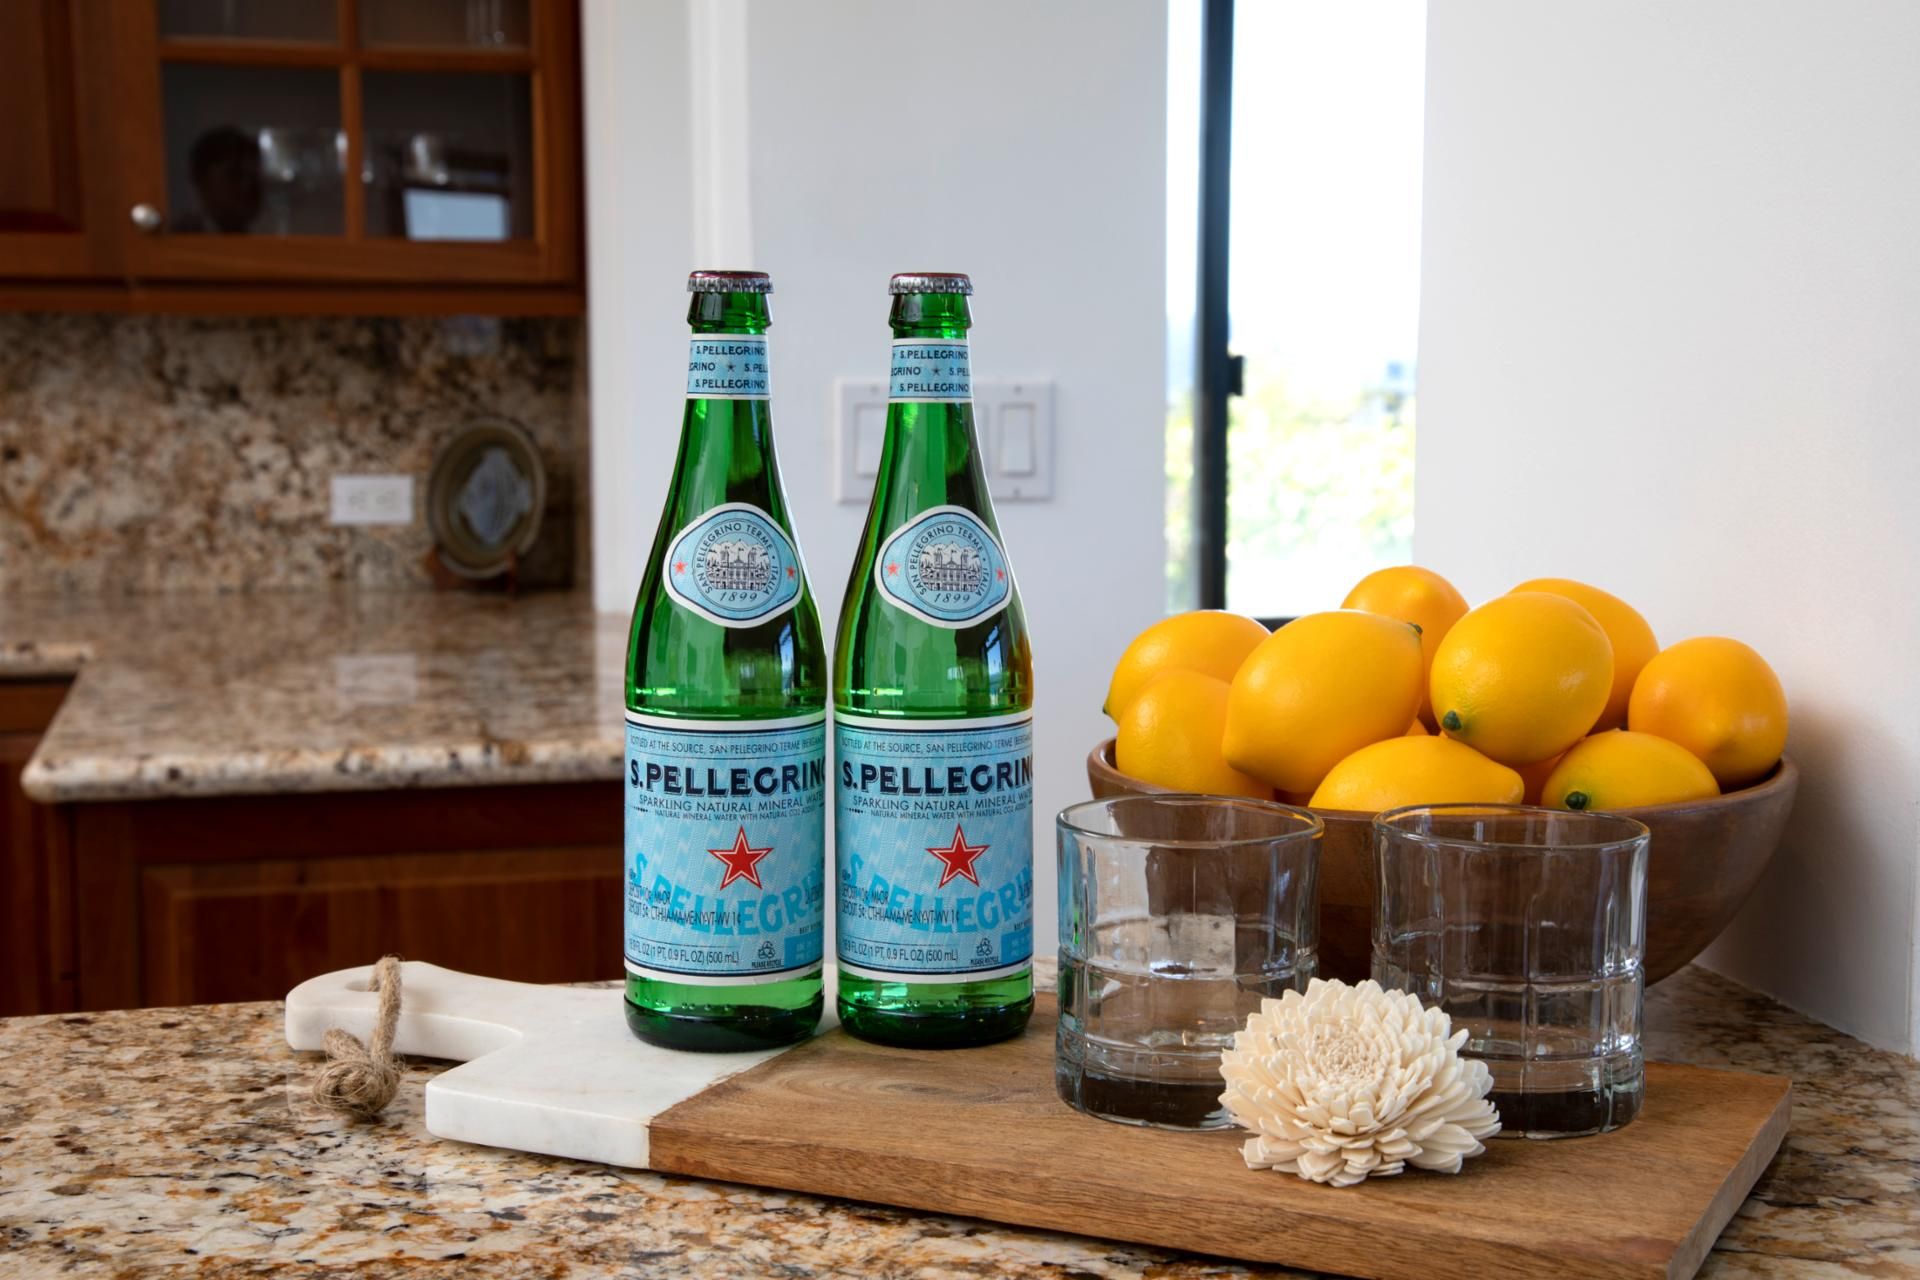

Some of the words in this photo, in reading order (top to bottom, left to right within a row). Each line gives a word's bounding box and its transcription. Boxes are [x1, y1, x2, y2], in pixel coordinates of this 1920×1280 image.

[696, 522, 742, 569] PELLEGRINO
[746, 524, 773, 550] TERME
[958, 526, 983, 552] TERME
[910, 525, 954, 570] PELLEGRINO
[697, 574, 713, 594] SAN
[765, 566, 778, 595] ITALIA
[911, 575, 927, 595] SAN
[975, 568, 989, 597] ITALIA
[719, 591, 757, 602] 1899
[934, 593, 970, 603] 1899
[658, 740, 670, 751] THE
[672, 742, 705, 755] SOURCE,
[709, 744, 727, 754] SAN
[731, 742, 778, 754] PELLEGRINO
[780, 740, 800, 751] TERME
[873, 741, 886, 752] THE
[888, 742, 923, 754] SOURCE,
[926, 743, 944, 753] SAN
[947, 741, 992, 753] PELLEGRINO
[994, 738, 1012, 748] TERME
[842, 752, 1033, 796] S.PELLEGRIN
[639, 794, 692, 811] SPARKLING
[696, 801, 753, 812] NATURAL
[758, 798, 803, 811] MINERAL
[853, 795, 909, 811] SPARKLING
[914, 800, 969, 811] NATURAL
[974, 796, 1016, 809] MINERAL
[654, 809, 681, 819] NATURAL
[682, 811, 712, 821] MINERAL
[713, 812, 737, 821] WATER
[739, 812, 758, 822] WITH
[759, 810, 788, 820] NATURAL
[871, 809, 897, 819] NATURAL
[900, 811, 930, 820] MINERAL
[931, 812, 955, 820] WATER
[956, 811, 974, 820] WITH
[976, 808, 1002, 818] NATURAL
[657, 945, 667, 961] PT,
[667, 948, 679, 960] 0.9
[680, 949, 689, 962] FL
[691, 950, 704, 965] OZ)
[706, 951, 722, 965] (500
[725, 951, 740, 964] mL)
[858, 943, 867, 956] OZ
[875, 946, 885, 960] PT,
[886, 947, 898, 960] 0.9
[899, 948, 909, 960] FL
[910, 949, 924, 964] OZ)
[926, 949, 942, 963] (500
[944, 948, 959, 963] mL)
